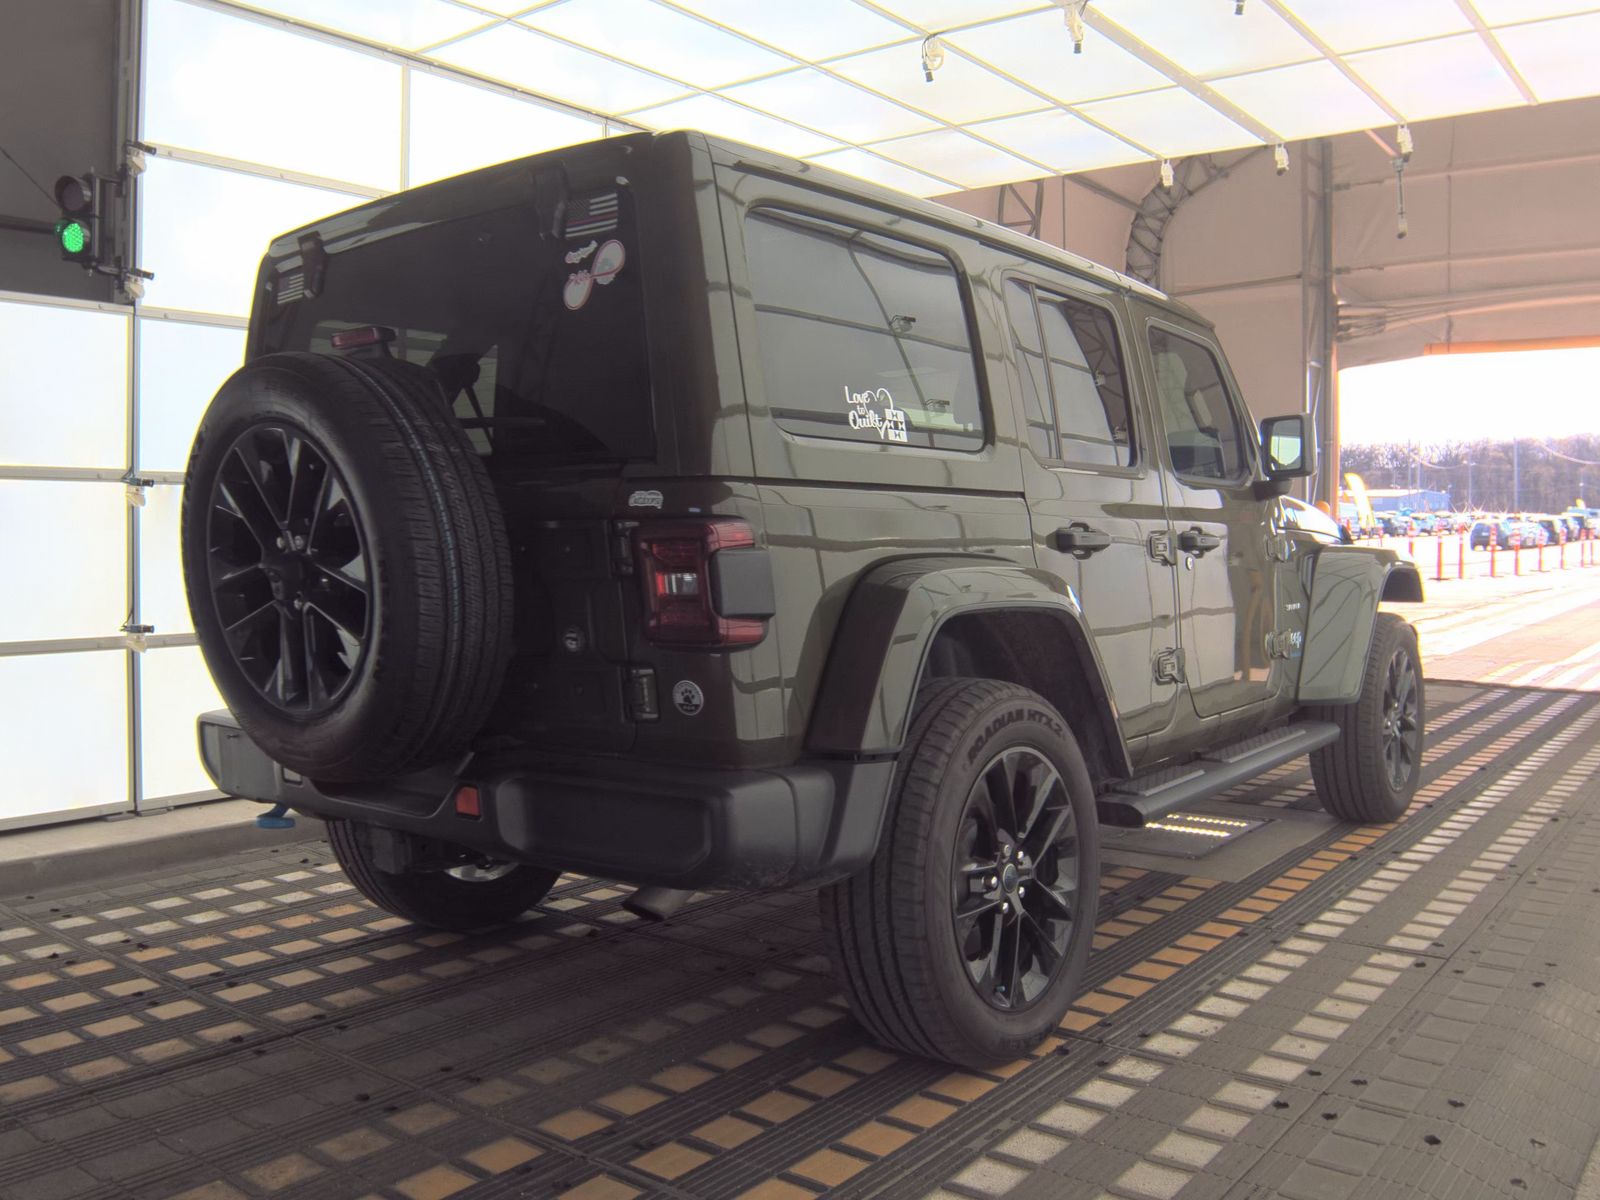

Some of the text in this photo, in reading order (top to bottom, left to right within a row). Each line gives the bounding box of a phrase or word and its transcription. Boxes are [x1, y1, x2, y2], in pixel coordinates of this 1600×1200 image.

[844, 386, 871, 404] Love
[856, 405, 866, 415] to
[848, 410, 883, 430] Quilt
